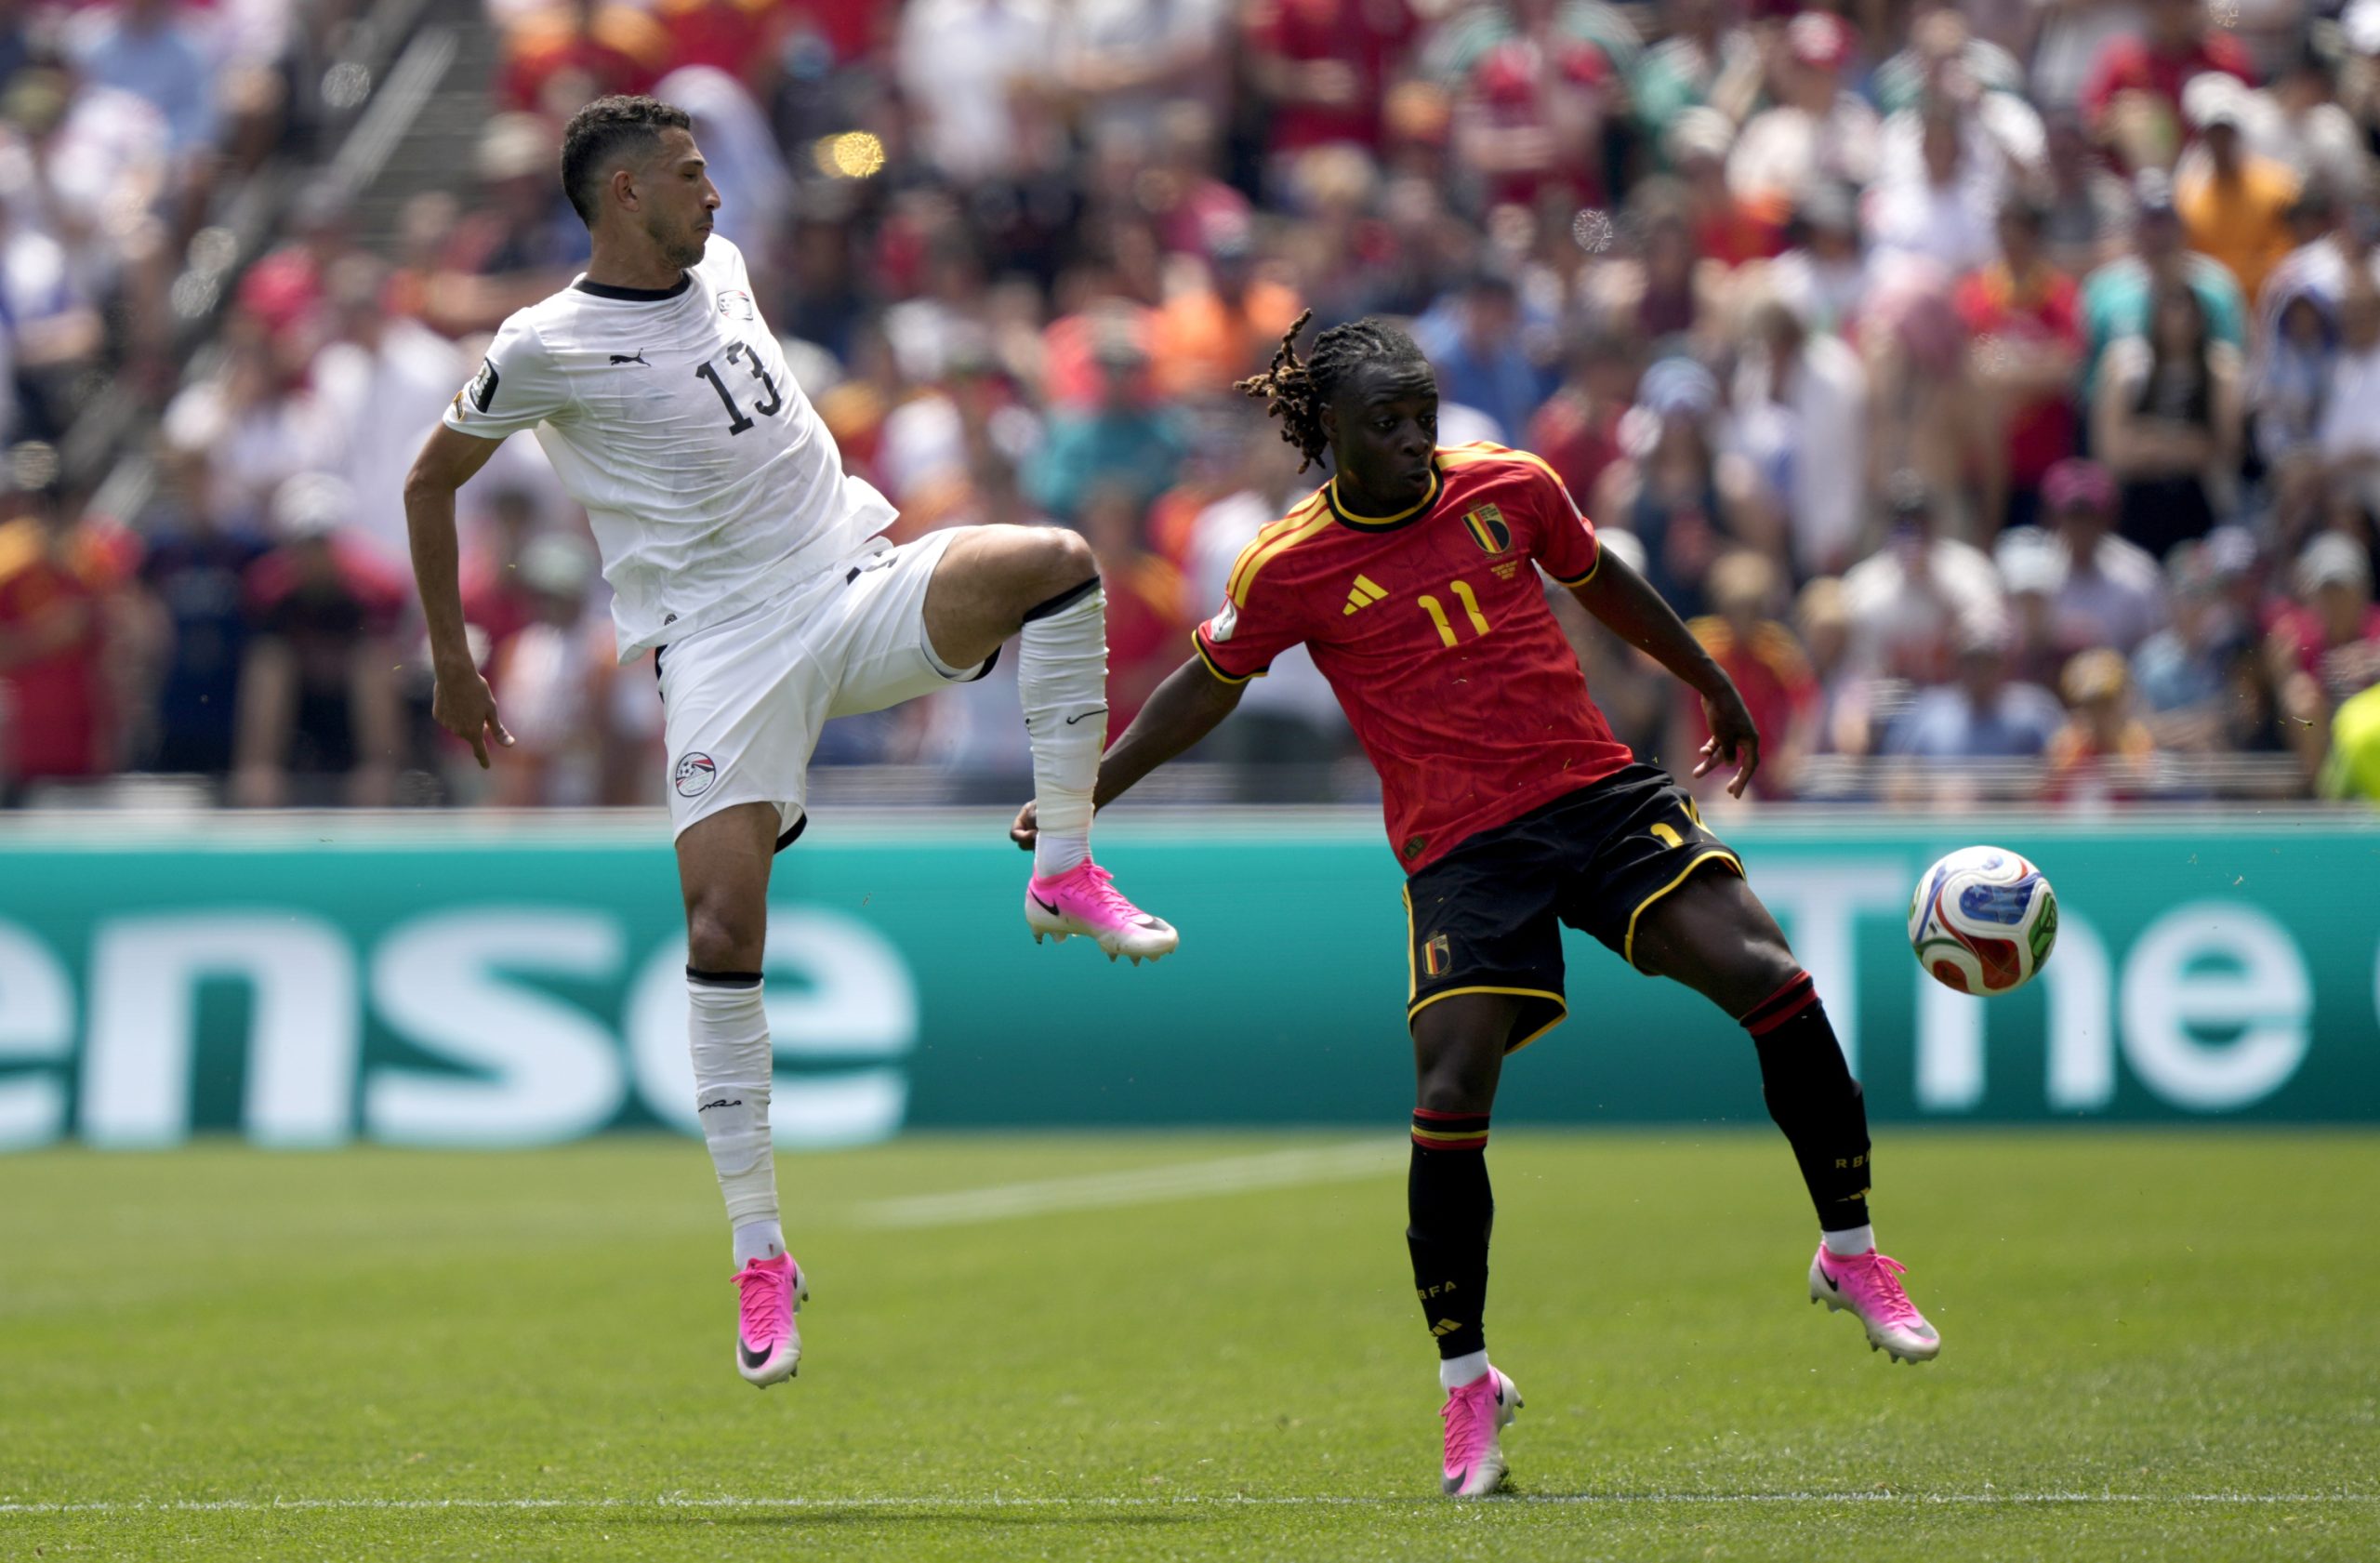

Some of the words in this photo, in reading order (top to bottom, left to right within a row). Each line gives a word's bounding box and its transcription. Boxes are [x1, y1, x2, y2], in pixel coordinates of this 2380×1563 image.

[694, 339, 782, 437] 13
[1417, 579, 1491, 649] 11
[0, 908, 916, 1146] nse
